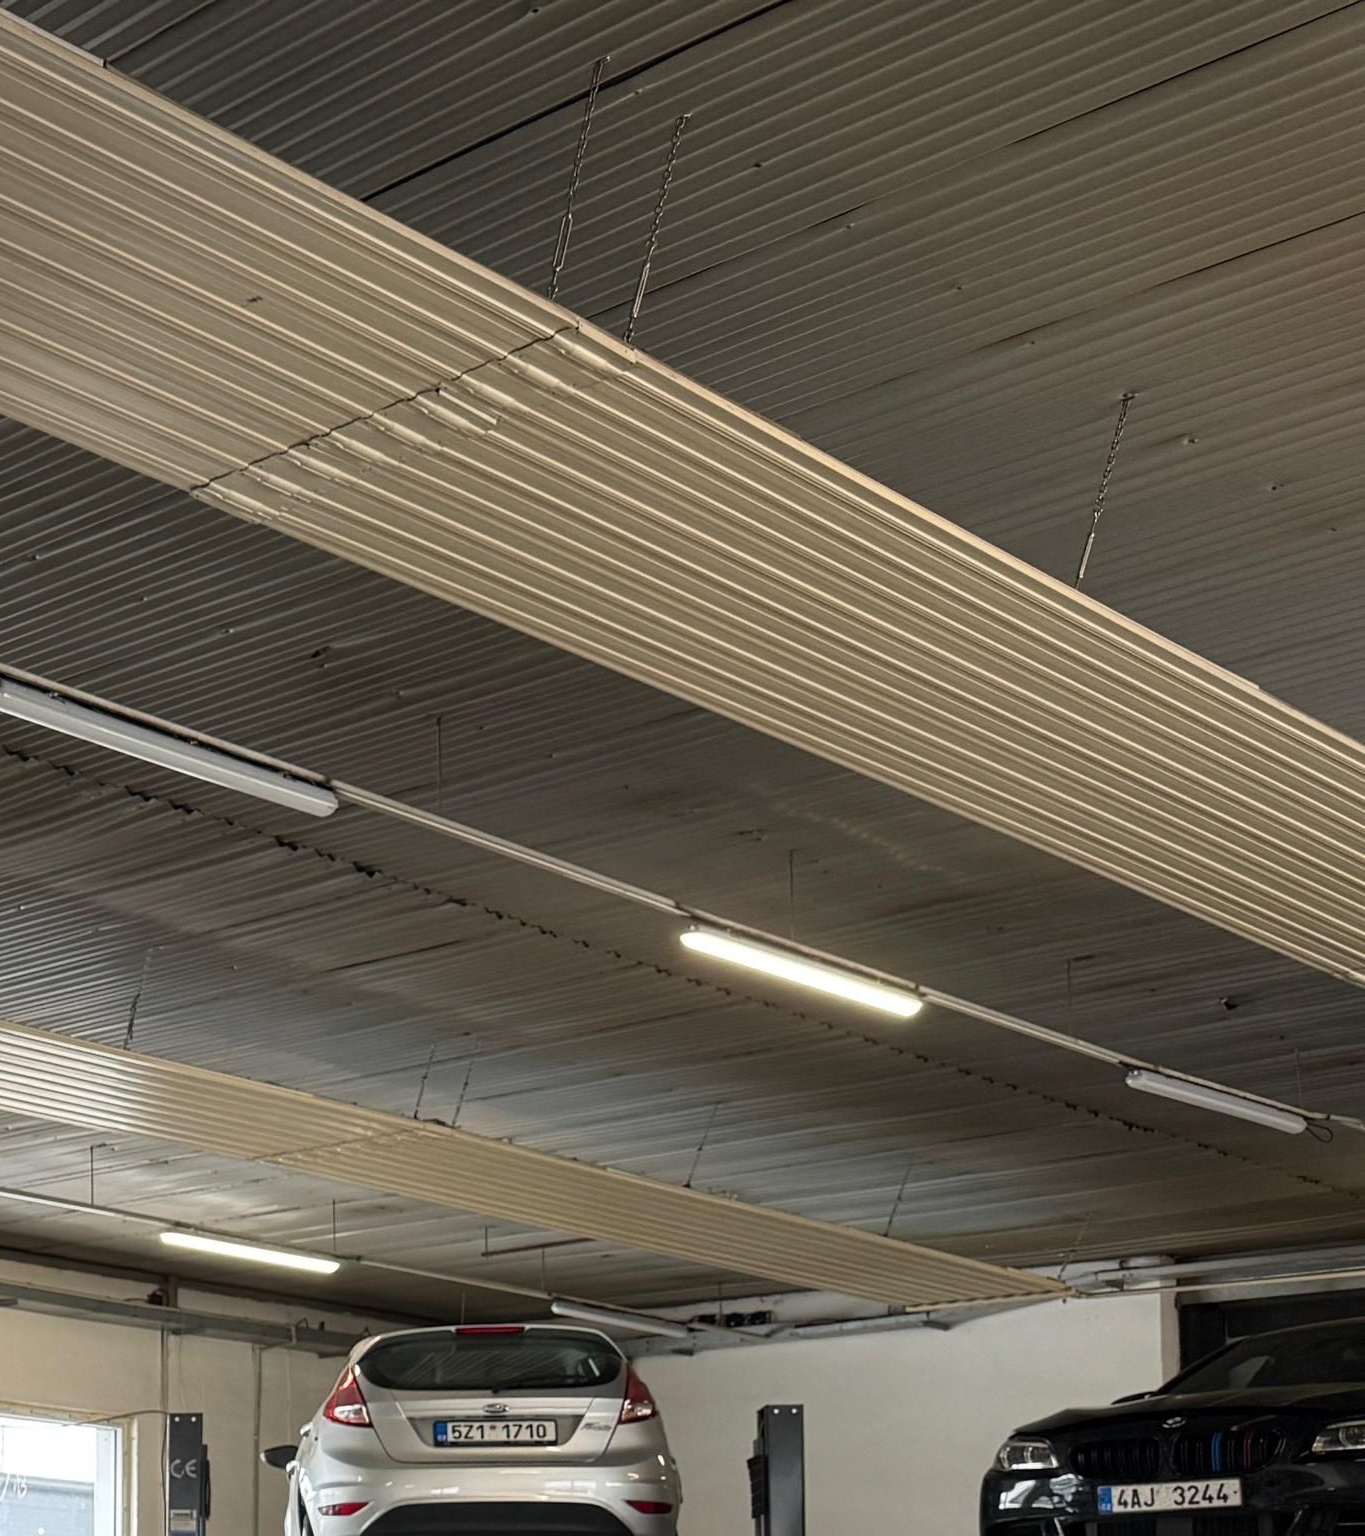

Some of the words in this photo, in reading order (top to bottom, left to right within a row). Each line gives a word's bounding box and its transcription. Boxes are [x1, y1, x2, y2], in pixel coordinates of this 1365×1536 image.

[452, 1424, 485, 1440] 5Z1
[502, 1423, 547, 1439] 1710
[170, 1459, 198, 1479] CE
[1117, 1487, 1155, 1509] 4AJ
[1172, 1483, 1229, 1506] 3244
